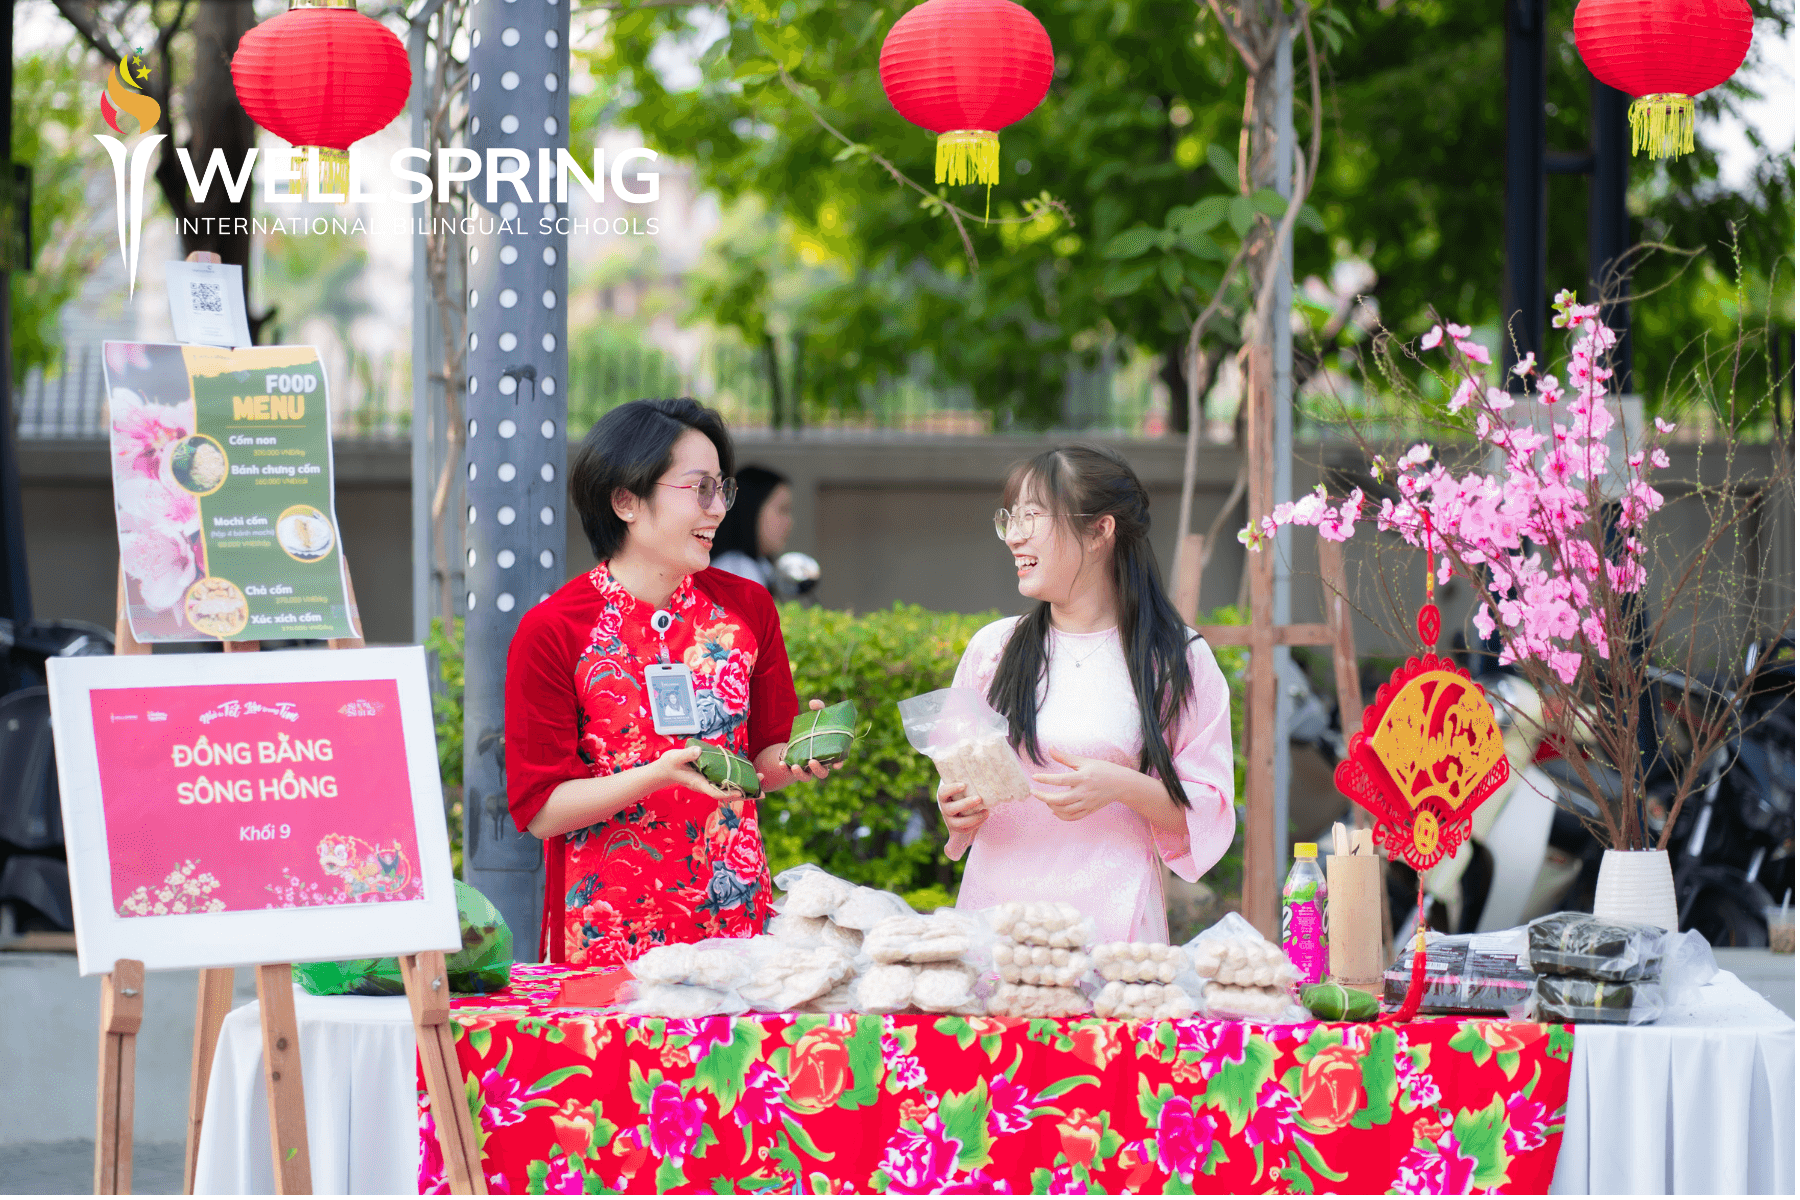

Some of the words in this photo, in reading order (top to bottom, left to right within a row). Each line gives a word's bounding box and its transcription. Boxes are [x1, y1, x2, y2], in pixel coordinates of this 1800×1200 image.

[266, 374, 317, 394] FOOD
[232, 395, 305, 421] MENU
[229, 434, 254, 446] Cốm
[255, 436, 277, 446] non
[231, 464, 259, 475] Bánh
[261, 464, 296, 477] chưng
[297, 462, 321, 474] cốm
[214, 516, 244, 526] Mochi
[246, 515, 268, 526] cốm
[245, 585, 268, 596] Chả
[269, 583, 293, 595] cốm
[250, 614, 274, 625] Xúc
[274, 612, 297, 624] xích
[298, 611, 322, 623] cốm
[171, 734, 252, 767] ĐỒNG
[257, 732, 333, 765] BẰNG
[176, 775, 253, 805] SÔNG
[258, 769, 339, 802] HỒNG
[239, 823, 276, 841] Khối
[279, 824, 291, 839] 9
